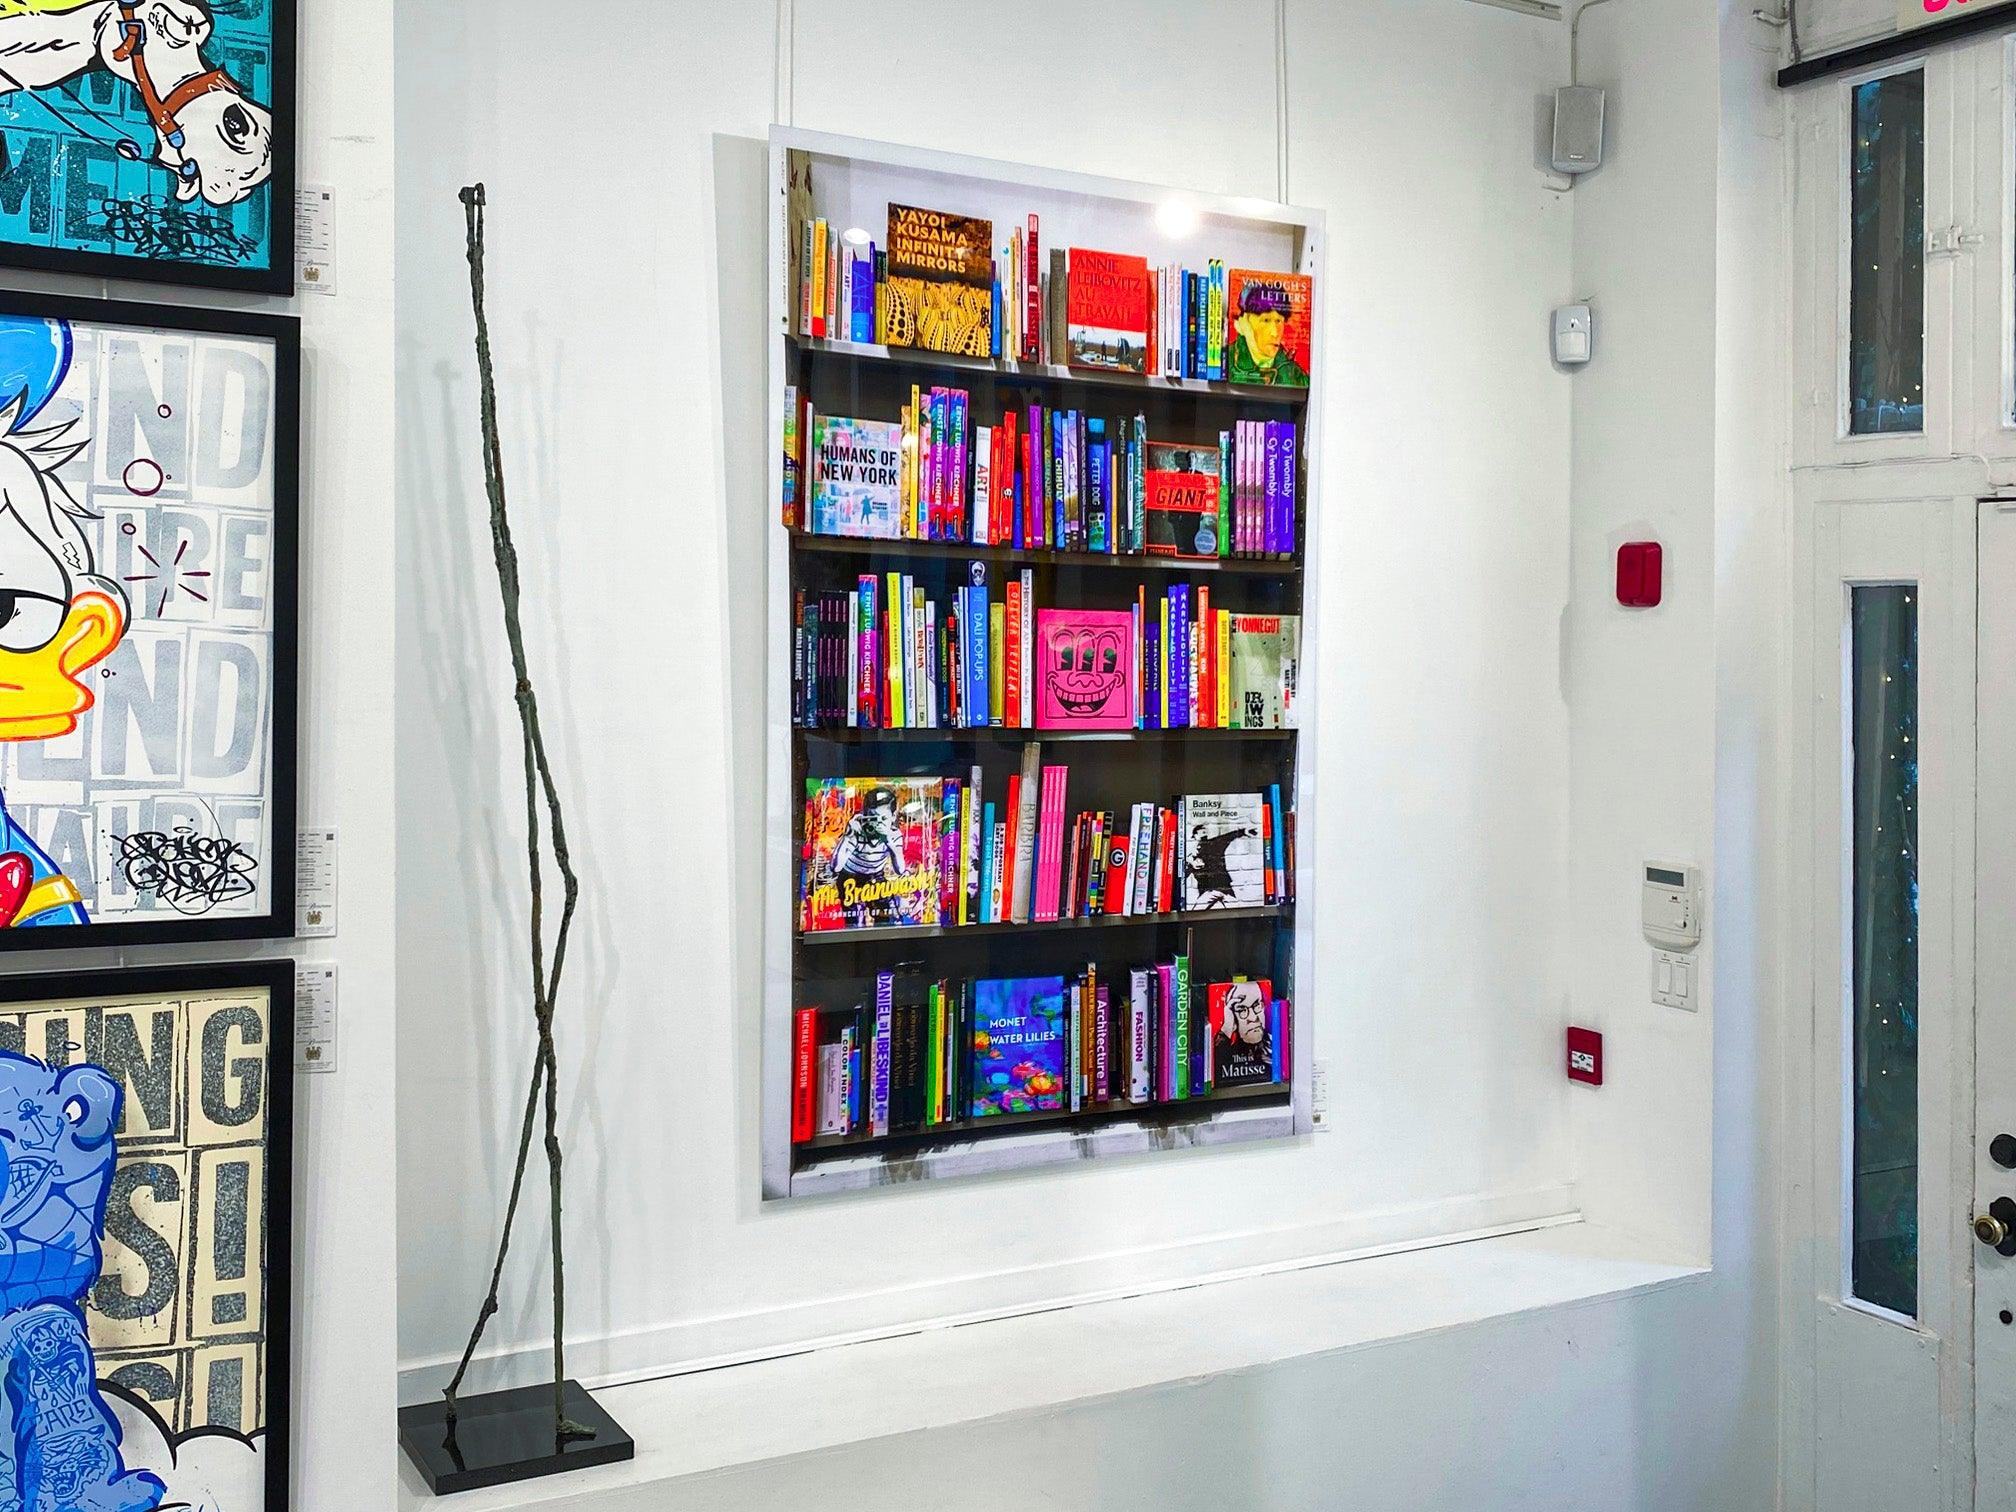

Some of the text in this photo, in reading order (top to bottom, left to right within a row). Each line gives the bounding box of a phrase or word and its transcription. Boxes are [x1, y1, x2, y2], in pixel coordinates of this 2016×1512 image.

[897, 207, 946, 229] YAYOI
[897, 222, 968, 247] KUSAMA
[896, 250, 966, 273] MIRRORS
[897, 238, 966, 260] INFINITY
[1075, 256, 1119, 274] ANNIE
[1075, 286, 1096, 302] AU
[1077, 271, 1142, 293] LEIBOVITZ
[1242, 276, 1263, 288] VAN
[1261, 290, 1307, 303] LETTERS
[936, 404, 944, 430] ERNST
[820, 444, 898, 466] HUMANS OF
[952, 406, 962, 507] ERNST LUDWIG KIRCHNER
[1266, 437, 1278, 497] Cy Twombly
[820, 462, 898, 486] NEW YORK
[977, 463, 988, 495] ART
[1056, 457, 1064, 503] CHIHULY
[1282, 438, 1292, 498] Cy Twombly
[934, 464, 942, 506] KIRCHNER
[1092, 458, 1100, 506] PETER DOIG
[1156, 487, 1207, 507] GIANT
[1008, 592, 1018, 636] OLIVER
[863, 592, 874, 694] ERNST LUDWIG KIRCHNER
[973, 638, 983, 681] POP-UPS
[1192, 800, 1222, 810] Banksy
[1020, 803, 1036, 862] BARBRA
[1137, 808, 1152, 880] FREEHAND
[800, 1012, 810, 1048] MICHAEL
[990, 1016, 1027, 1028] MONET
[1177, 970, 1188, 1066] GARDEN CITY
[876, 973, 891, 1102] DANIEL LIBESKIND
[990, 1031, 1056, 1044] WATER LILIES
[1096, 1000, 1107, 1078] Architecture
[800, 1050, 808, 1088] JOHNSON
[1222, 1062, 1266, 1078] Matisse
[1232, 1054, 1247, 1063] This
[840, 1108, 846, 1120] XL
